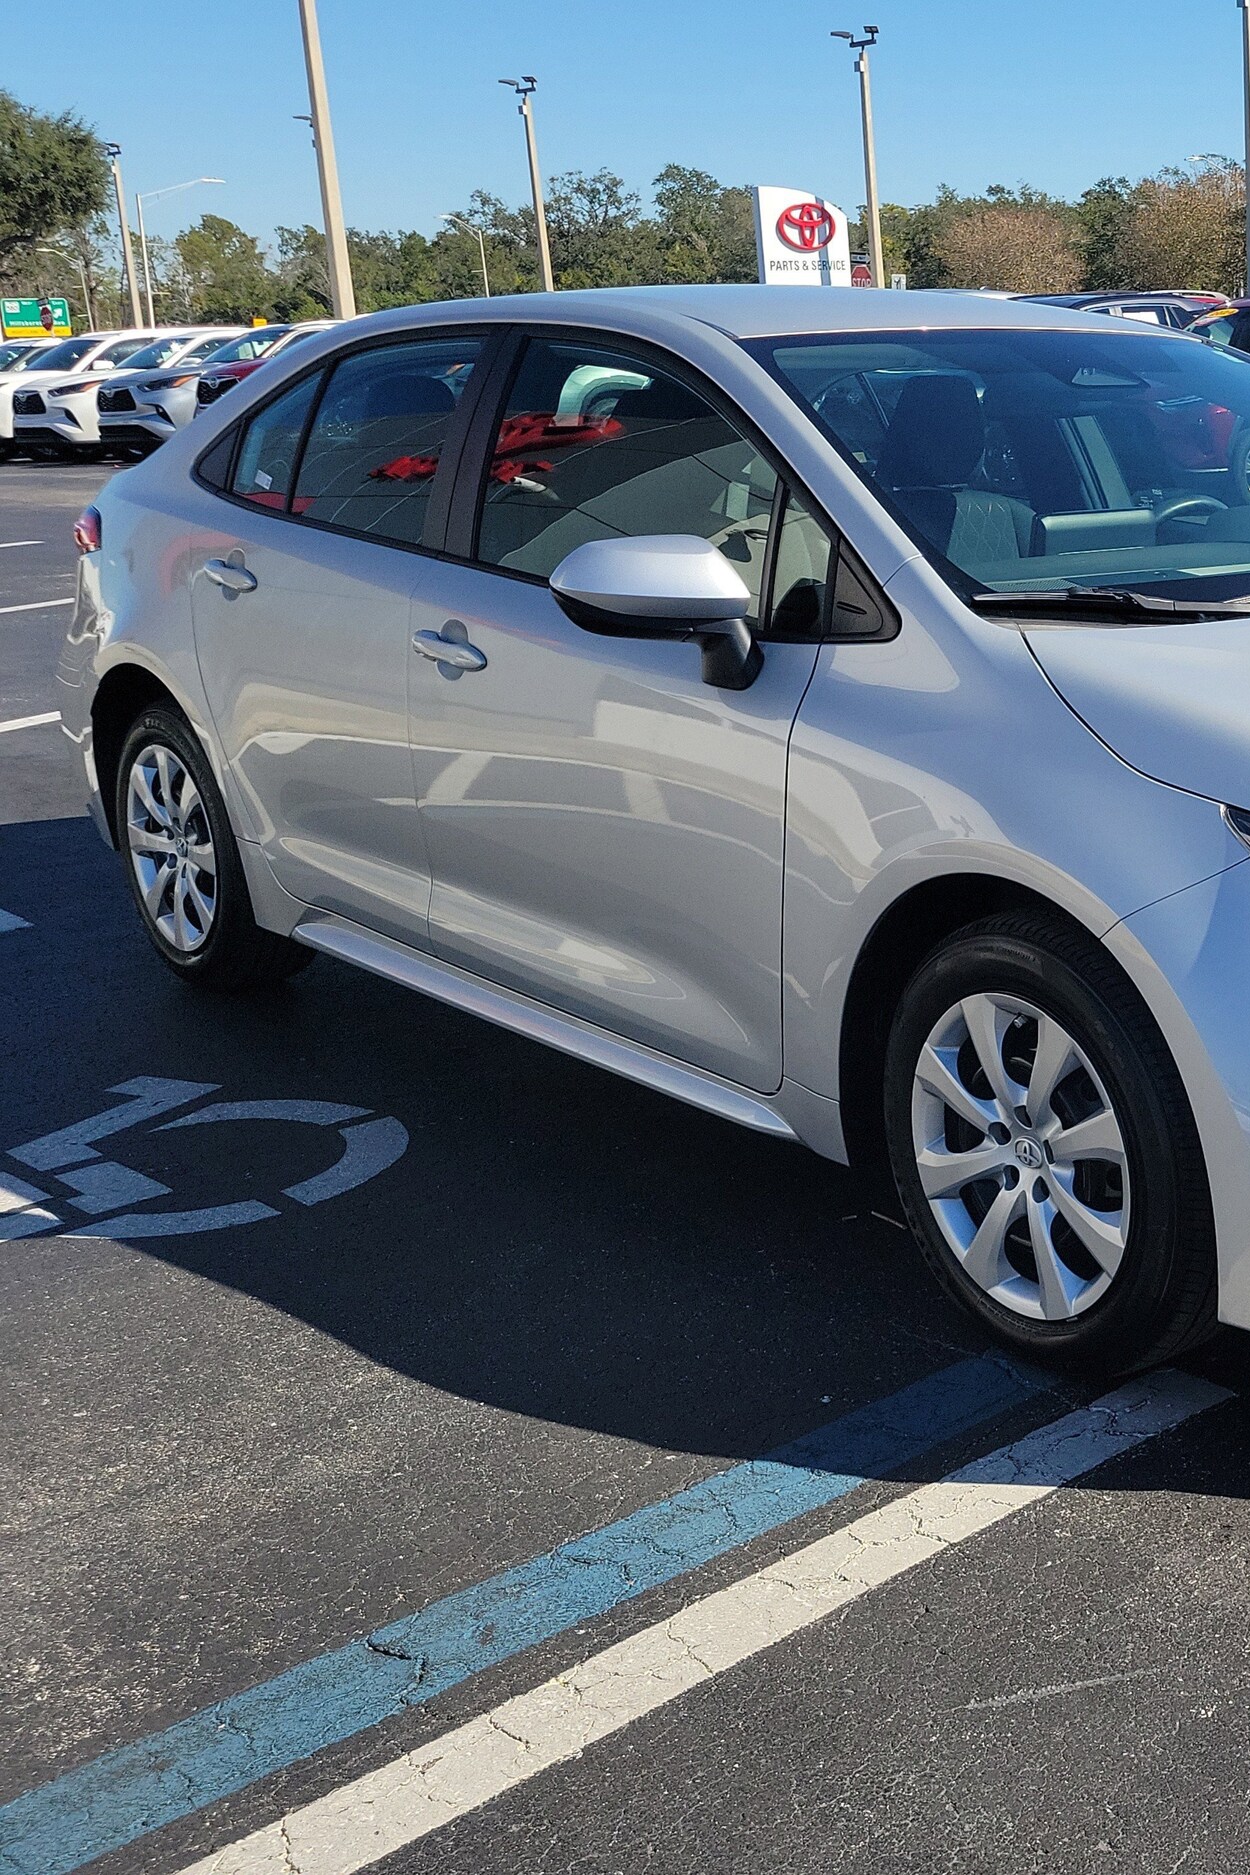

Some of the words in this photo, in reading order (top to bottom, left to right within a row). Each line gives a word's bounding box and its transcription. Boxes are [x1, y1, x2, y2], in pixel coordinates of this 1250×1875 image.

[770, 260, 800, 271] PARTS
[802, 260, 809, 271] &
[811, 260, 846, 271] SERVICE
[852, 278, 872, 288] STOP
